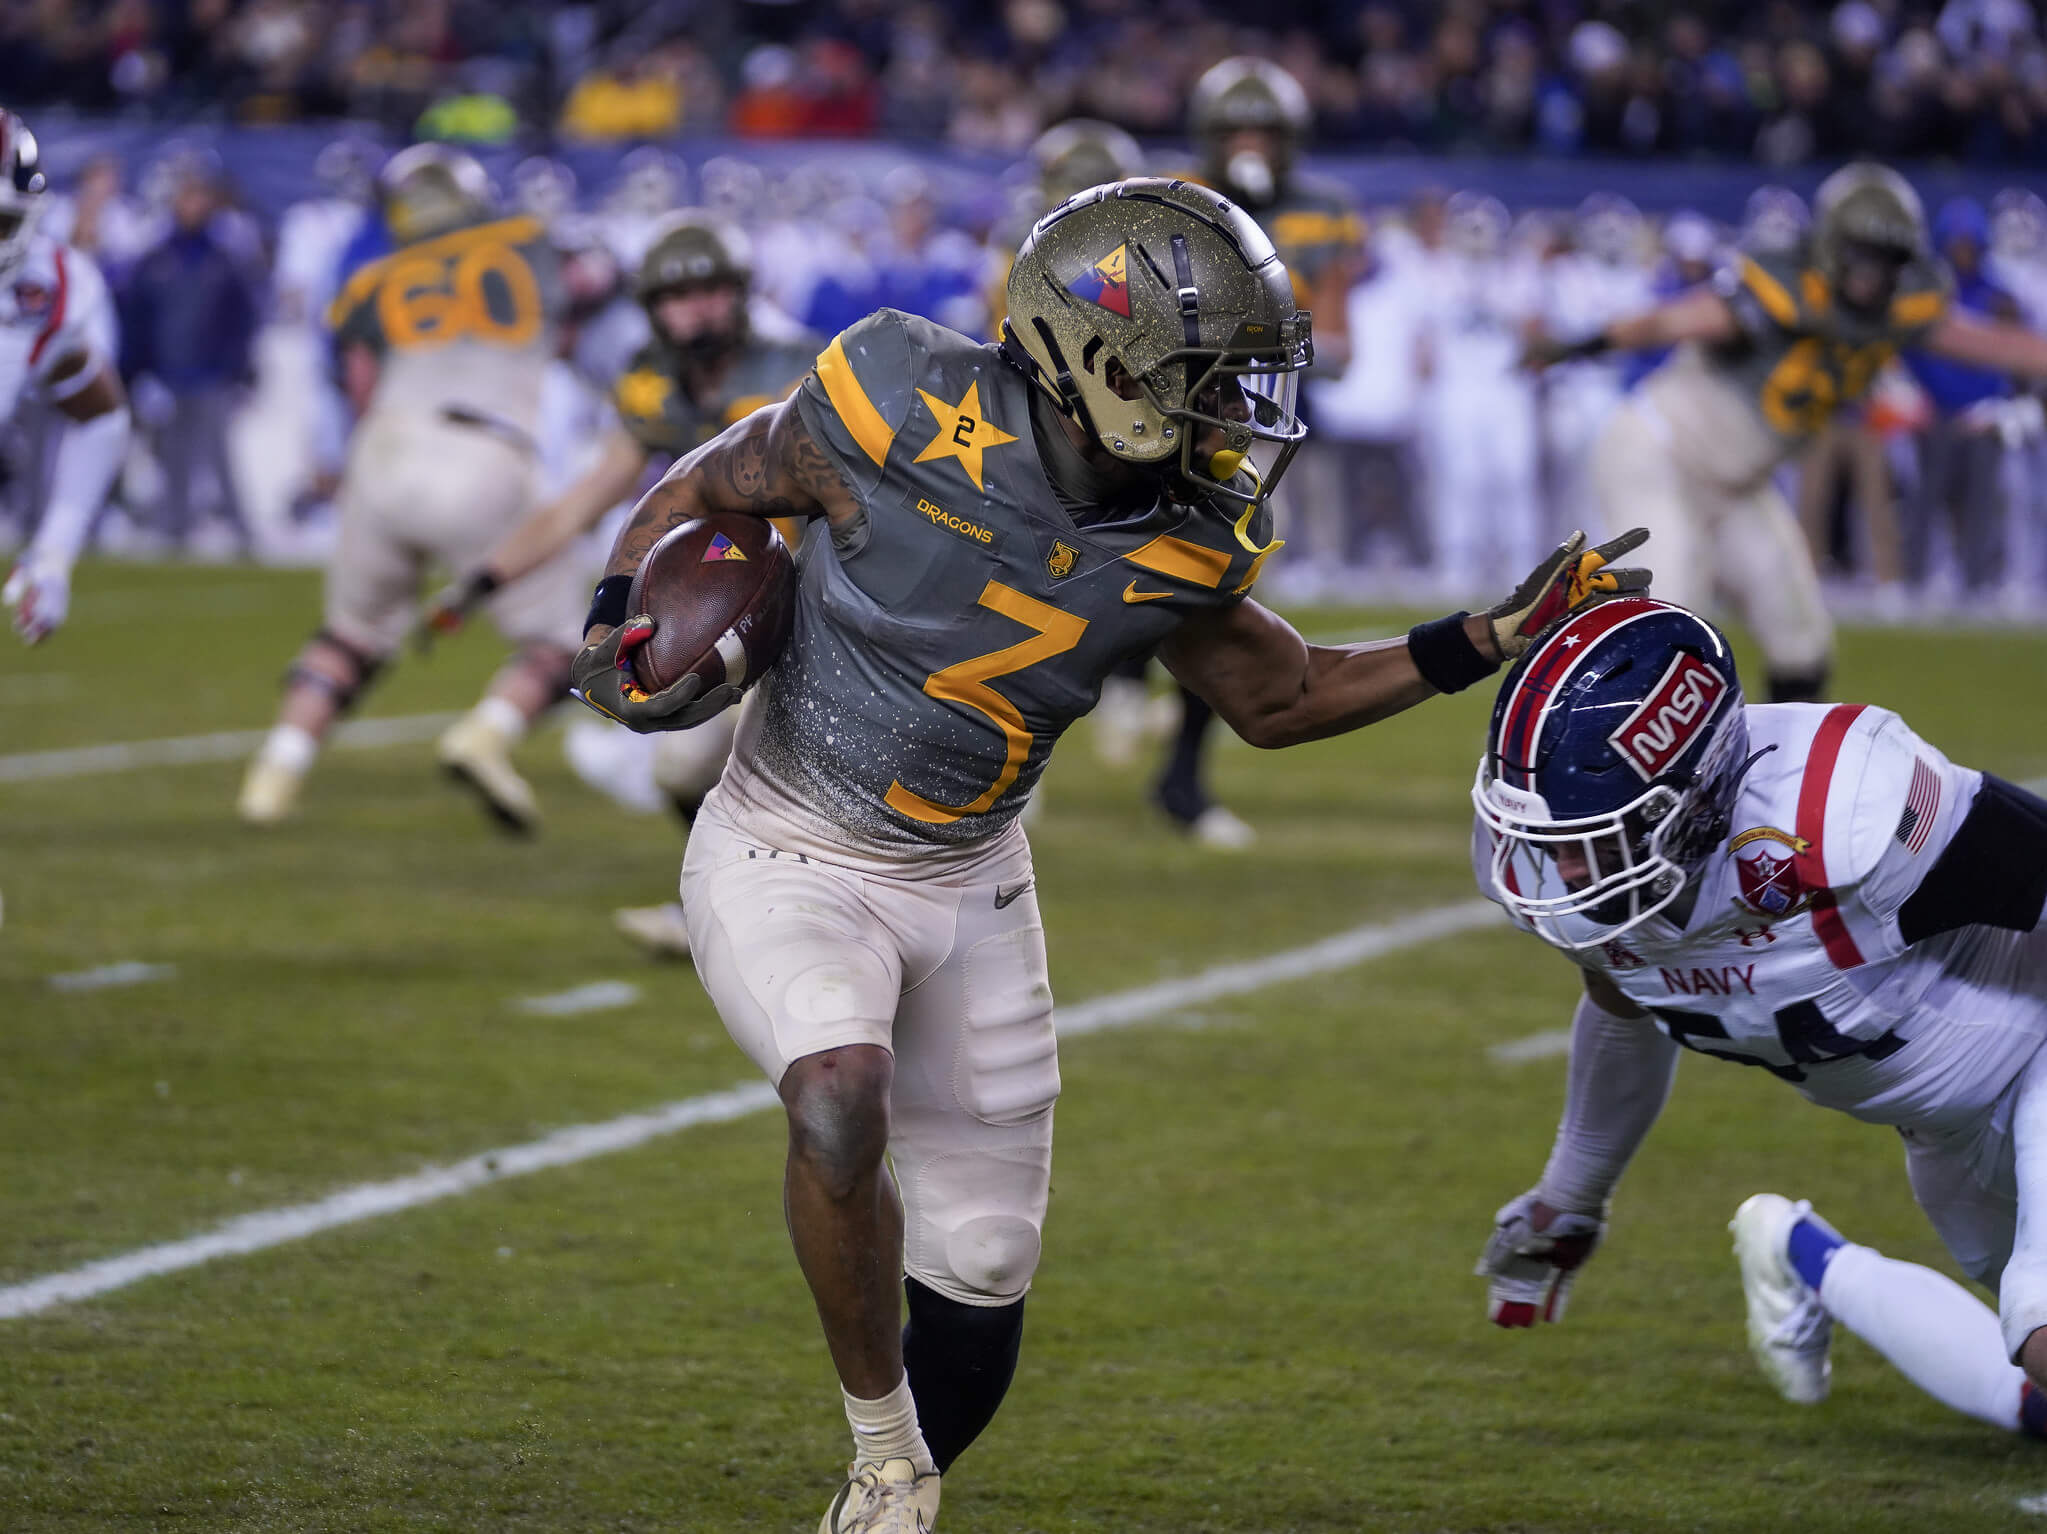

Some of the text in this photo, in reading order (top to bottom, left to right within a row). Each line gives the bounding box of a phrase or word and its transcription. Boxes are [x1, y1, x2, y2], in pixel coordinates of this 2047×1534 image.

[376, 245, 543, 350] 60
[953, 414, 976, 449] 2
[916, 498, 994, 544] DRAGONS
[883, 579, 1090, 824] 3
[1632, 668, 1715, 765] NASA
[1659, 963, 1757, 995] NAVY
